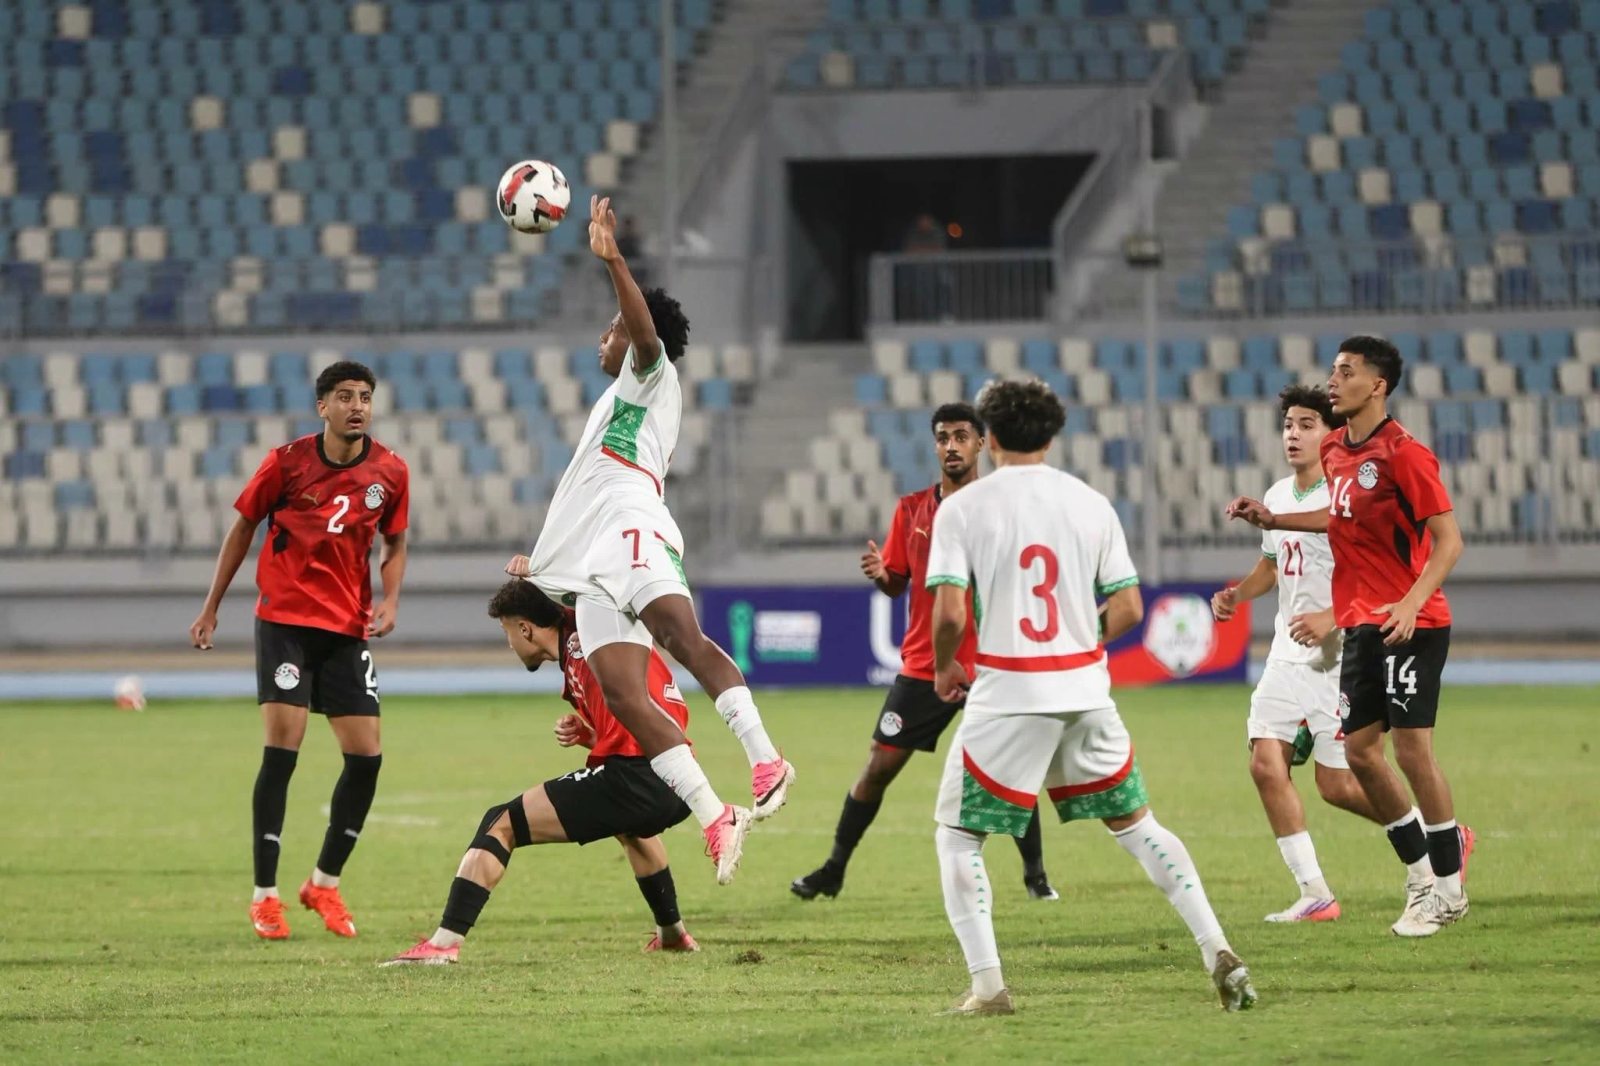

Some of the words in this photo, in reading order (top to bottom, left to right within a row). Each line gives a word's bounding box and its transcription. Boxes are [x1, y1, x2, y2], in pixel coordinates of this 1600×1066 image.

[327, 495, 350, 533] 2
[1329, 476, 1353, 517] 14
[622, 529, 640, 561] 7
[1282, 541, 1303, 576] 21
[1019, 544, 1059, 642] 3
[361, 650, 377, 688] 2
[1385, 655, 1417, 694] 14
